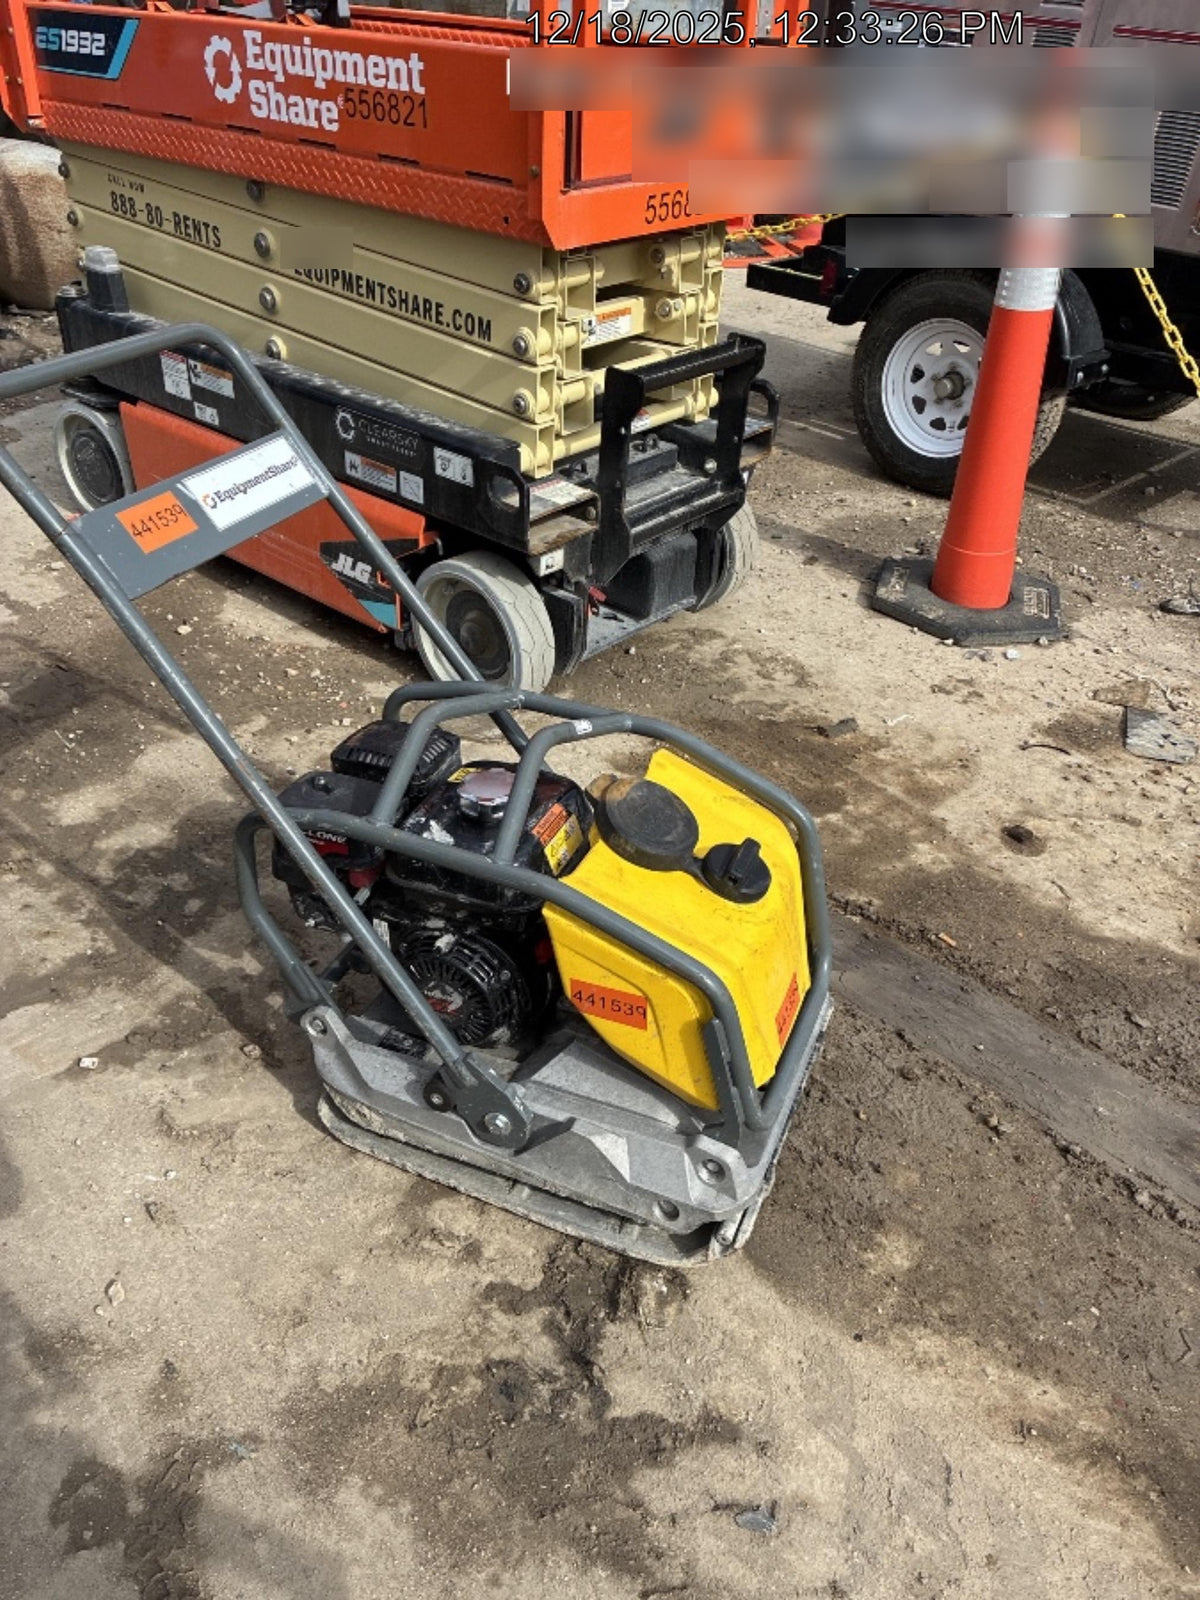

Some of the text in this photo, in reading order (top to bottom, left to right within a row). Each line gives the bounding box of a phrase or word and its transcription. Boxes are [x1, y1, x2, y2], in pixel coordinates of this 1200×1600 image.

[36, 26, 106, 56] ES1932
[243, 30, 425, 94] Equipment
[344, 88, 428, 129] 556821
[110, 190, 221, 248] 888-80-RENTS
[131, 503, 187, 539] 441539
[331, 553, 372, 584] JLG
[573, 989, 647, 1019] 441539
